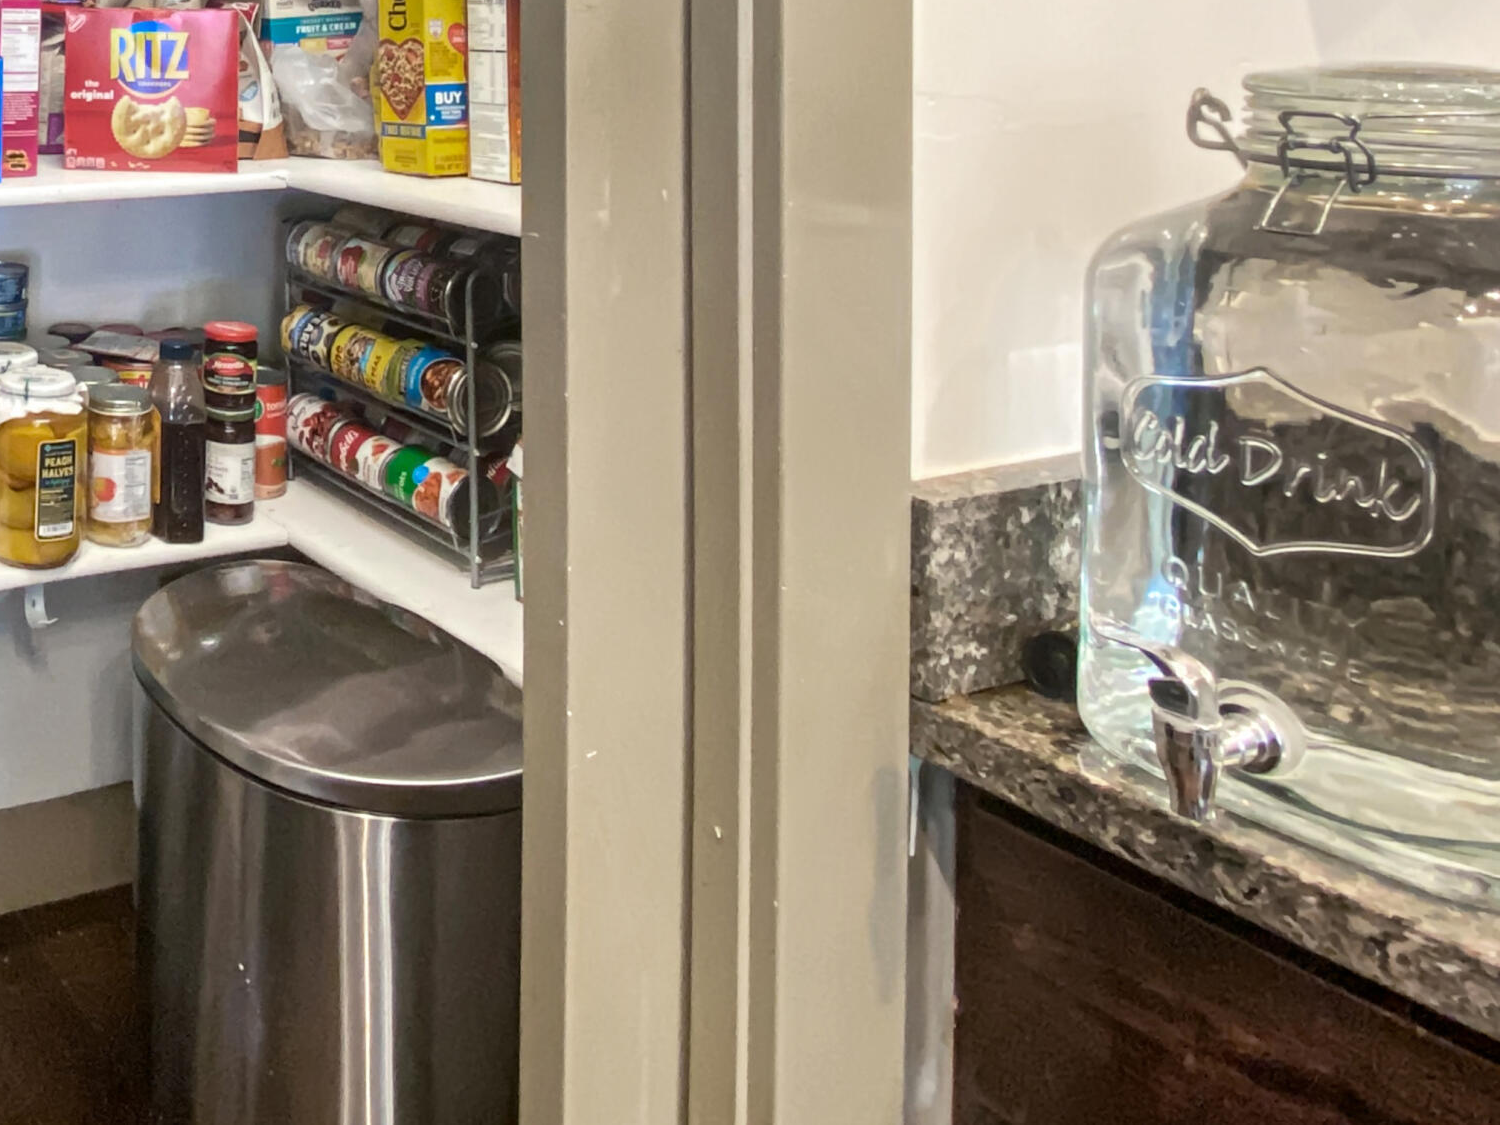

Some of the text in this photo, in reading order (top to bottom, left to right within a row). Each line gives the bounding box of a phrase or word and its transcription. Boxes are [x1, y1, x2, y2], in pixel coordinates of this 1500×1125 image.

[295, 25, 321, 35] FRUIT
[329, 21, 357, 31] CREAM
[110, 28, 190, 83] RITZ
[85, 80, 100, 88] the
[70, 89, 115, 103] original
[435, 90, 463, 105] BUY
[44, 456, 73, 467] PEACH
[1132, 410, 1422, 523] Cold Drink
[41, 465, 74, 478] HALVES
